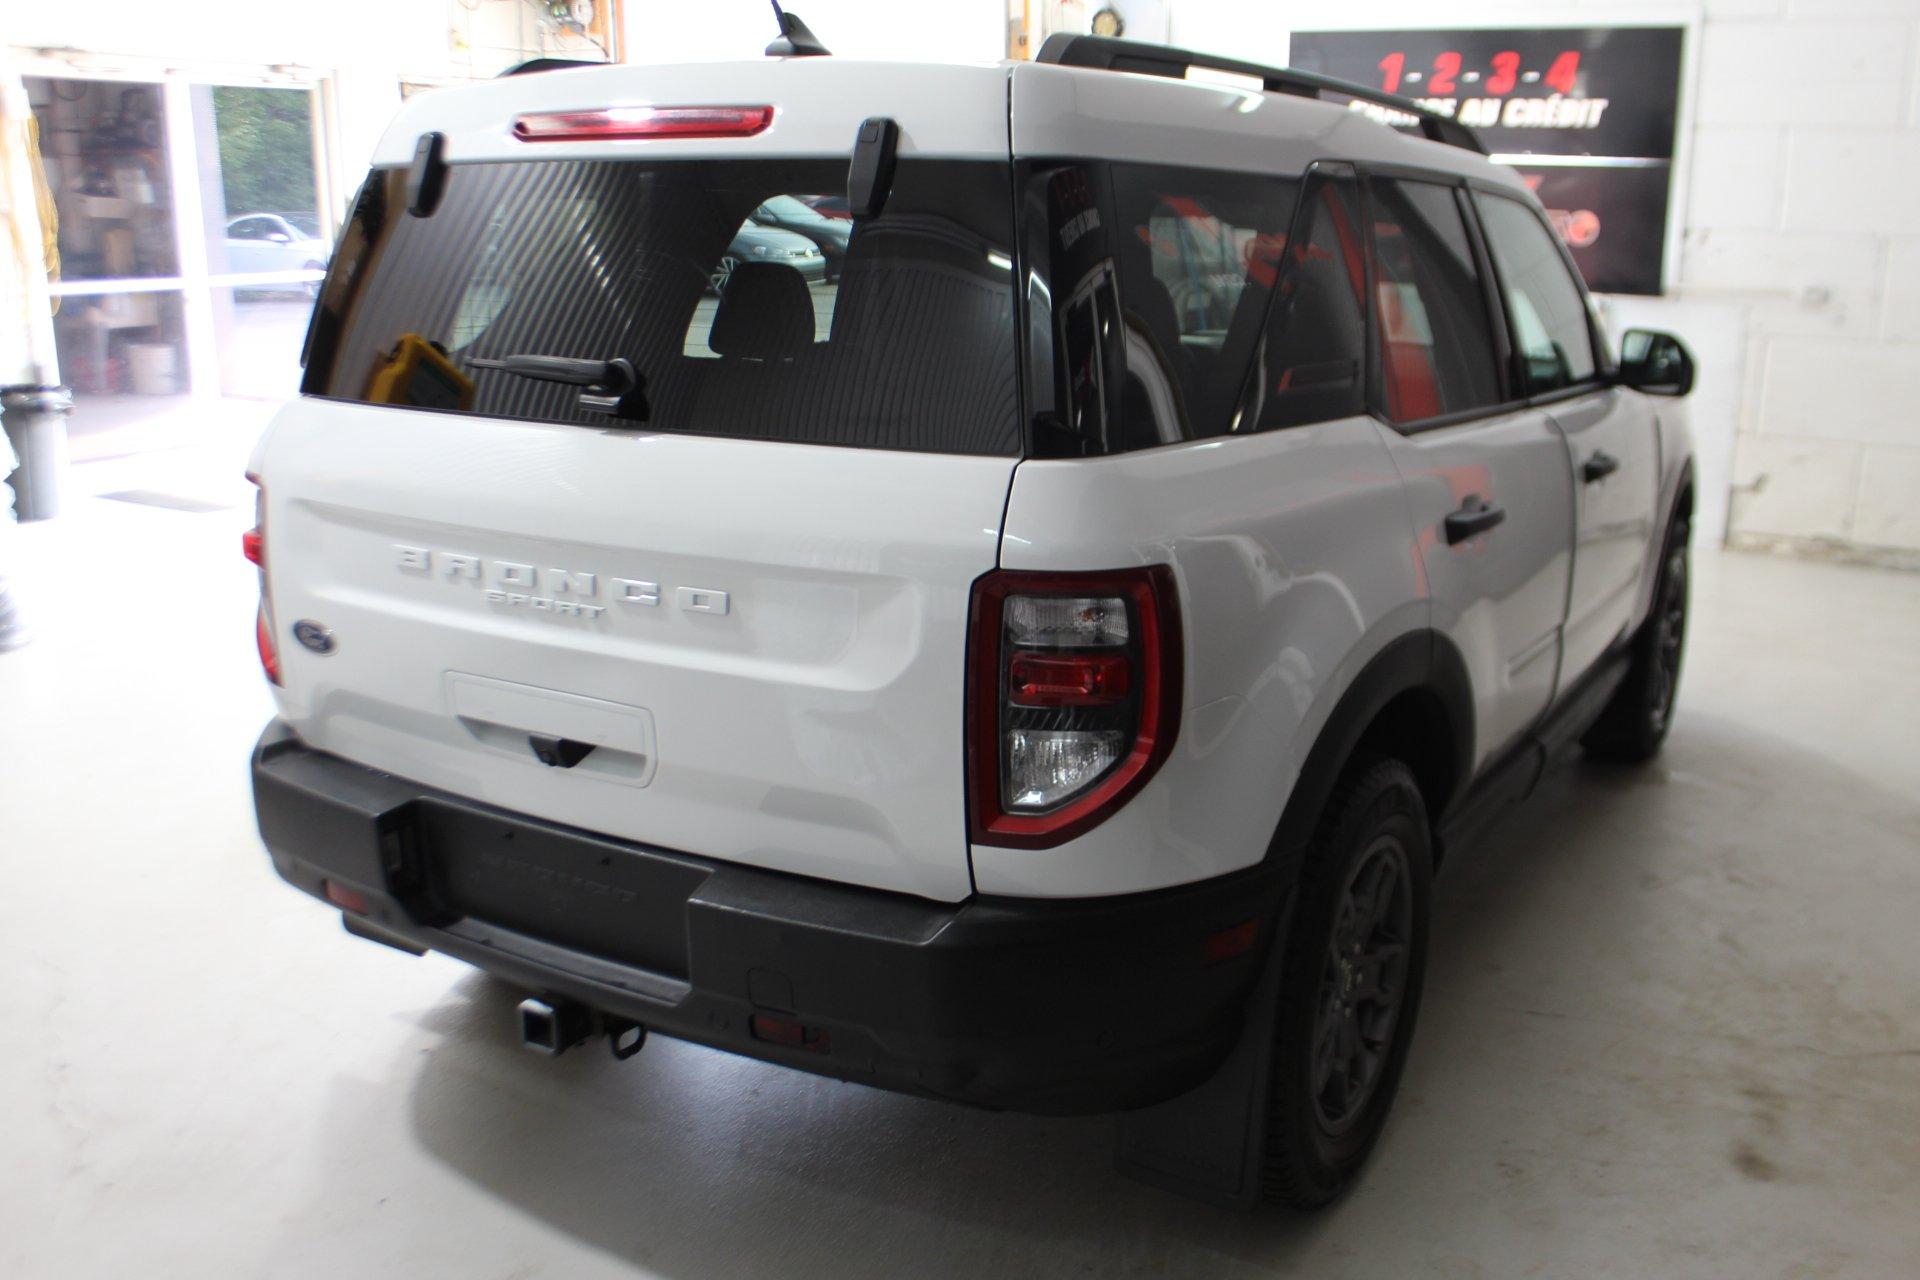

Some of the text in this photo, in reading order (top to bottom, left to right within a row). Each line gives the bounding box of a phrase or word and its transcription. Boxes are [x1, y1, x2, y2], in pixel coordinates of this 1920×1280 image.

[1457, 98, 1502, 128] AU
[392, 544, 730, 616] BRONCO
[484, 589, 606, 619] SPORT
